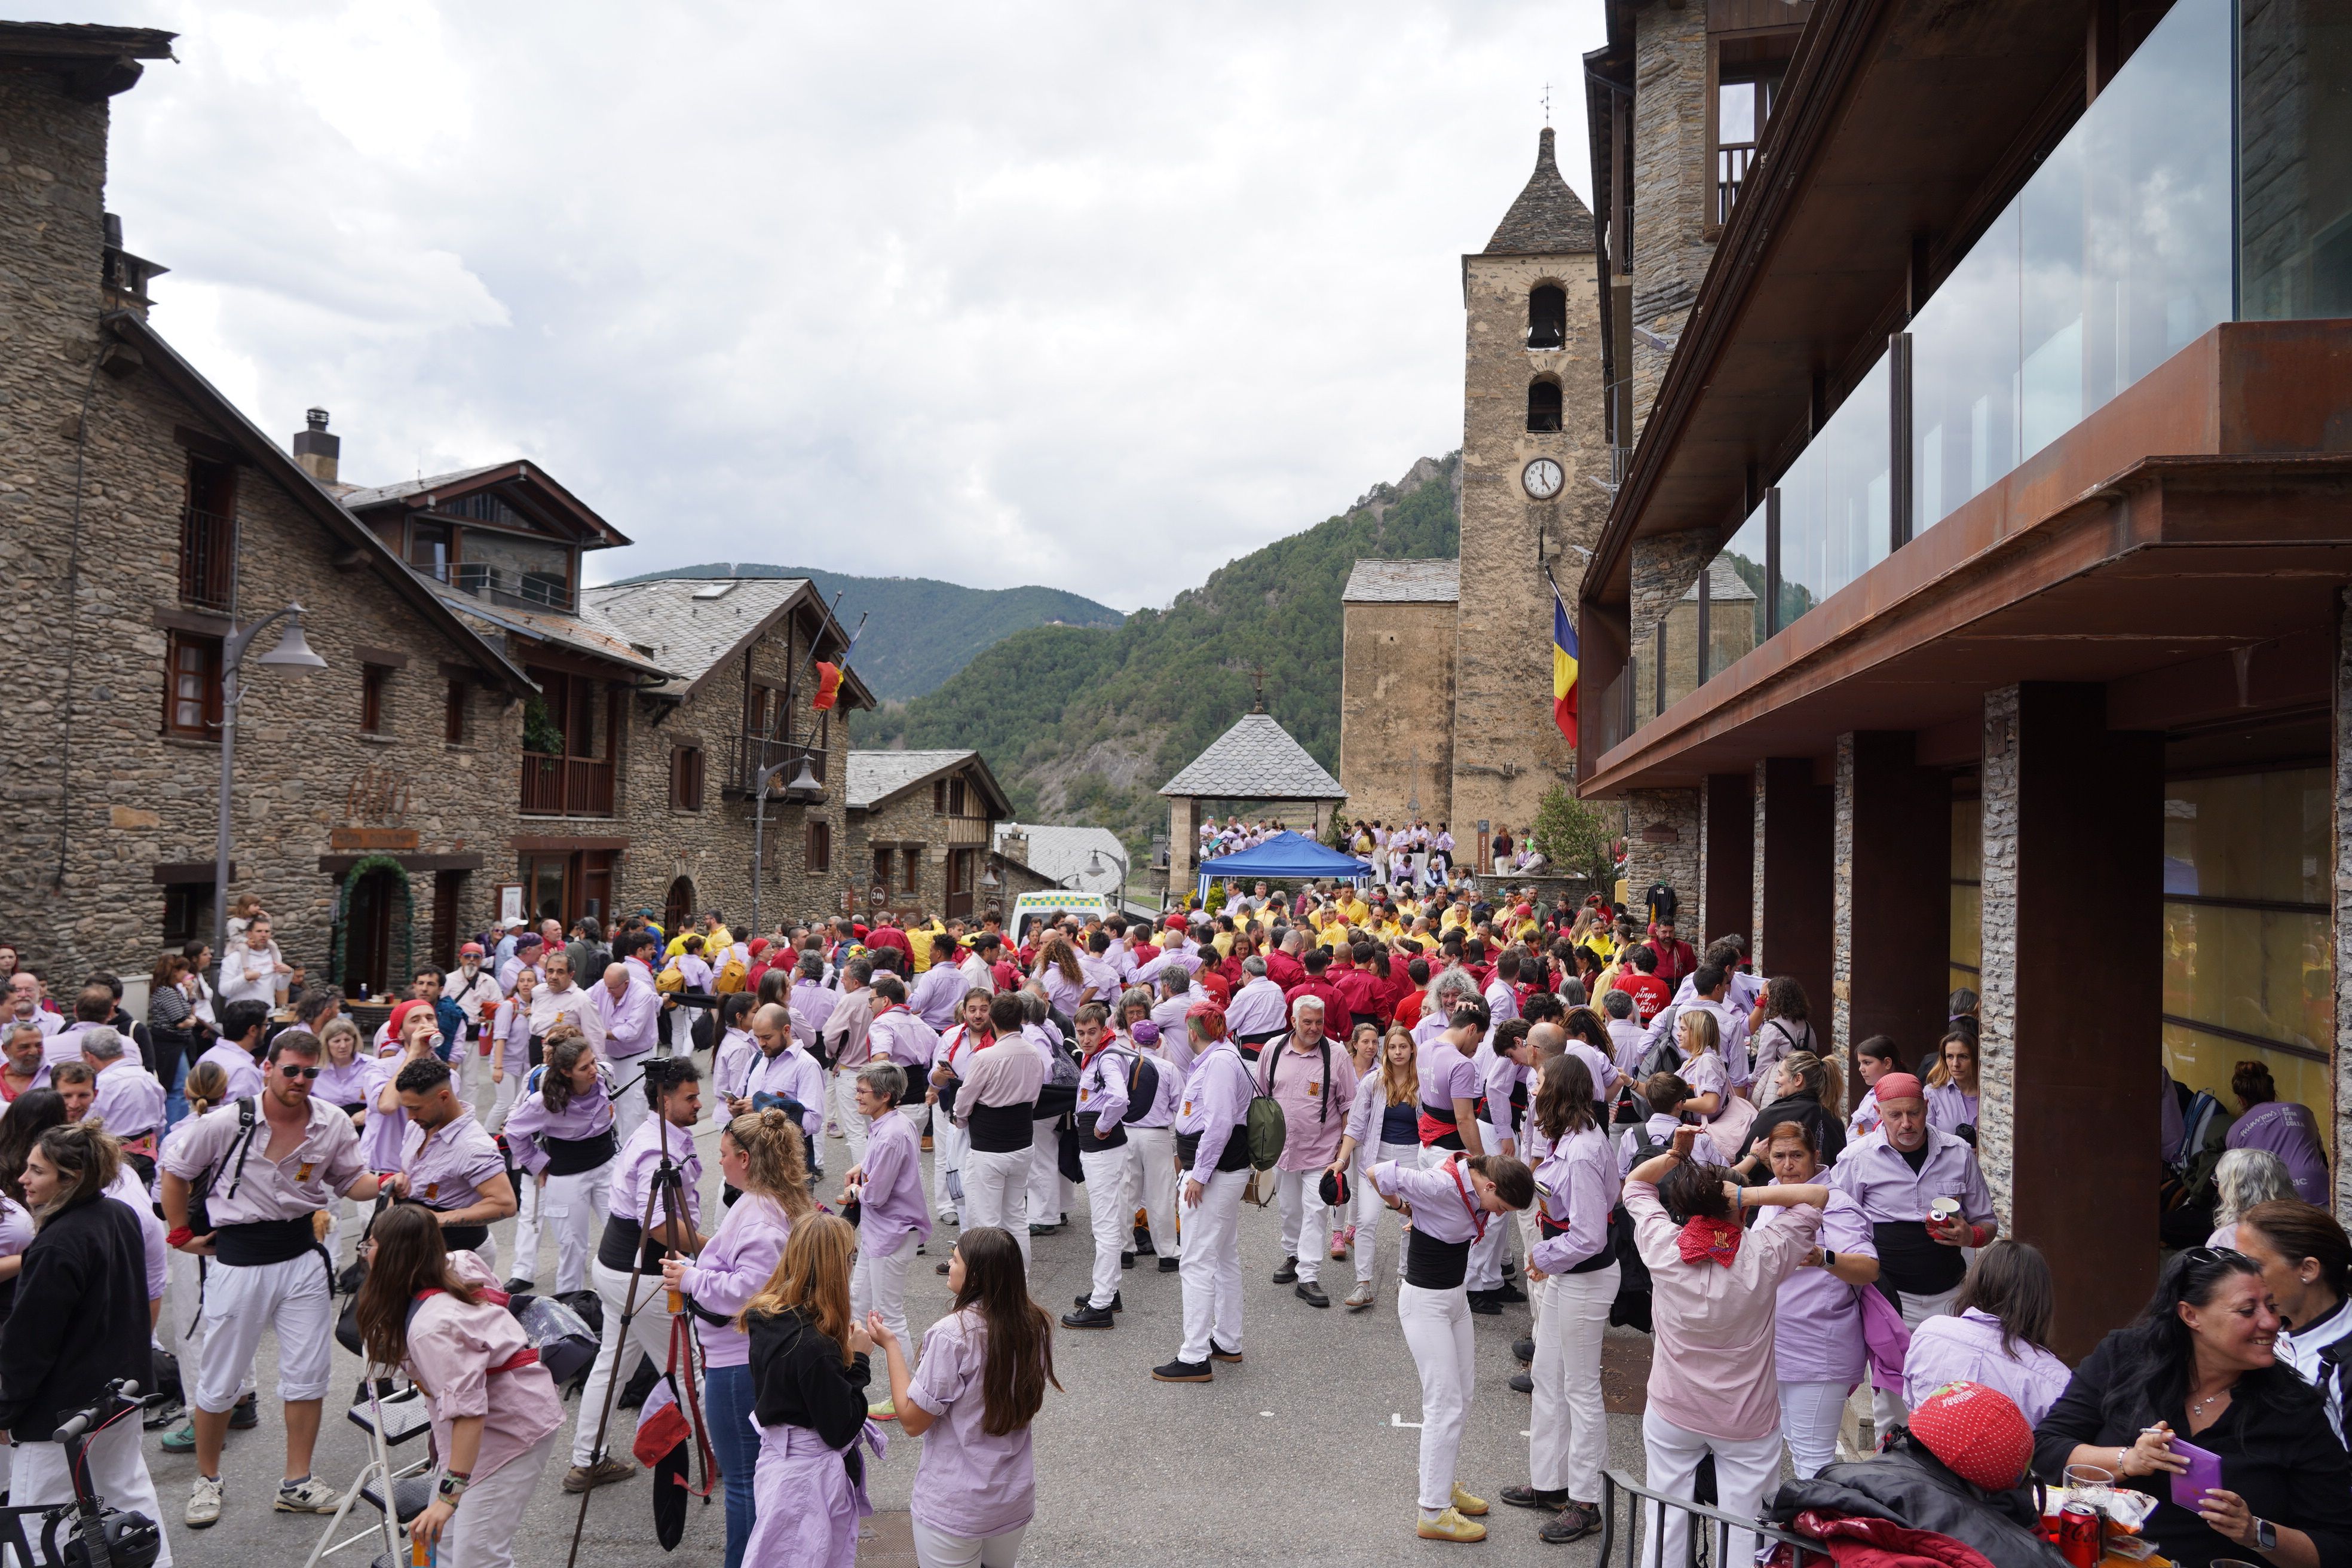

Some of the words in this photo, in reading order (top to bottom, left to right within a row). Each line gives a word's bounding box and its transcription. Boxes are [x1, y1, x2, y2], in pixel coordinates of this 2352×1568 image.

[1634, 990, 1658, 1002] pinya
[2240, 1110, 2277, 1138] minyons
[297, 1490, 313, 1501] N
